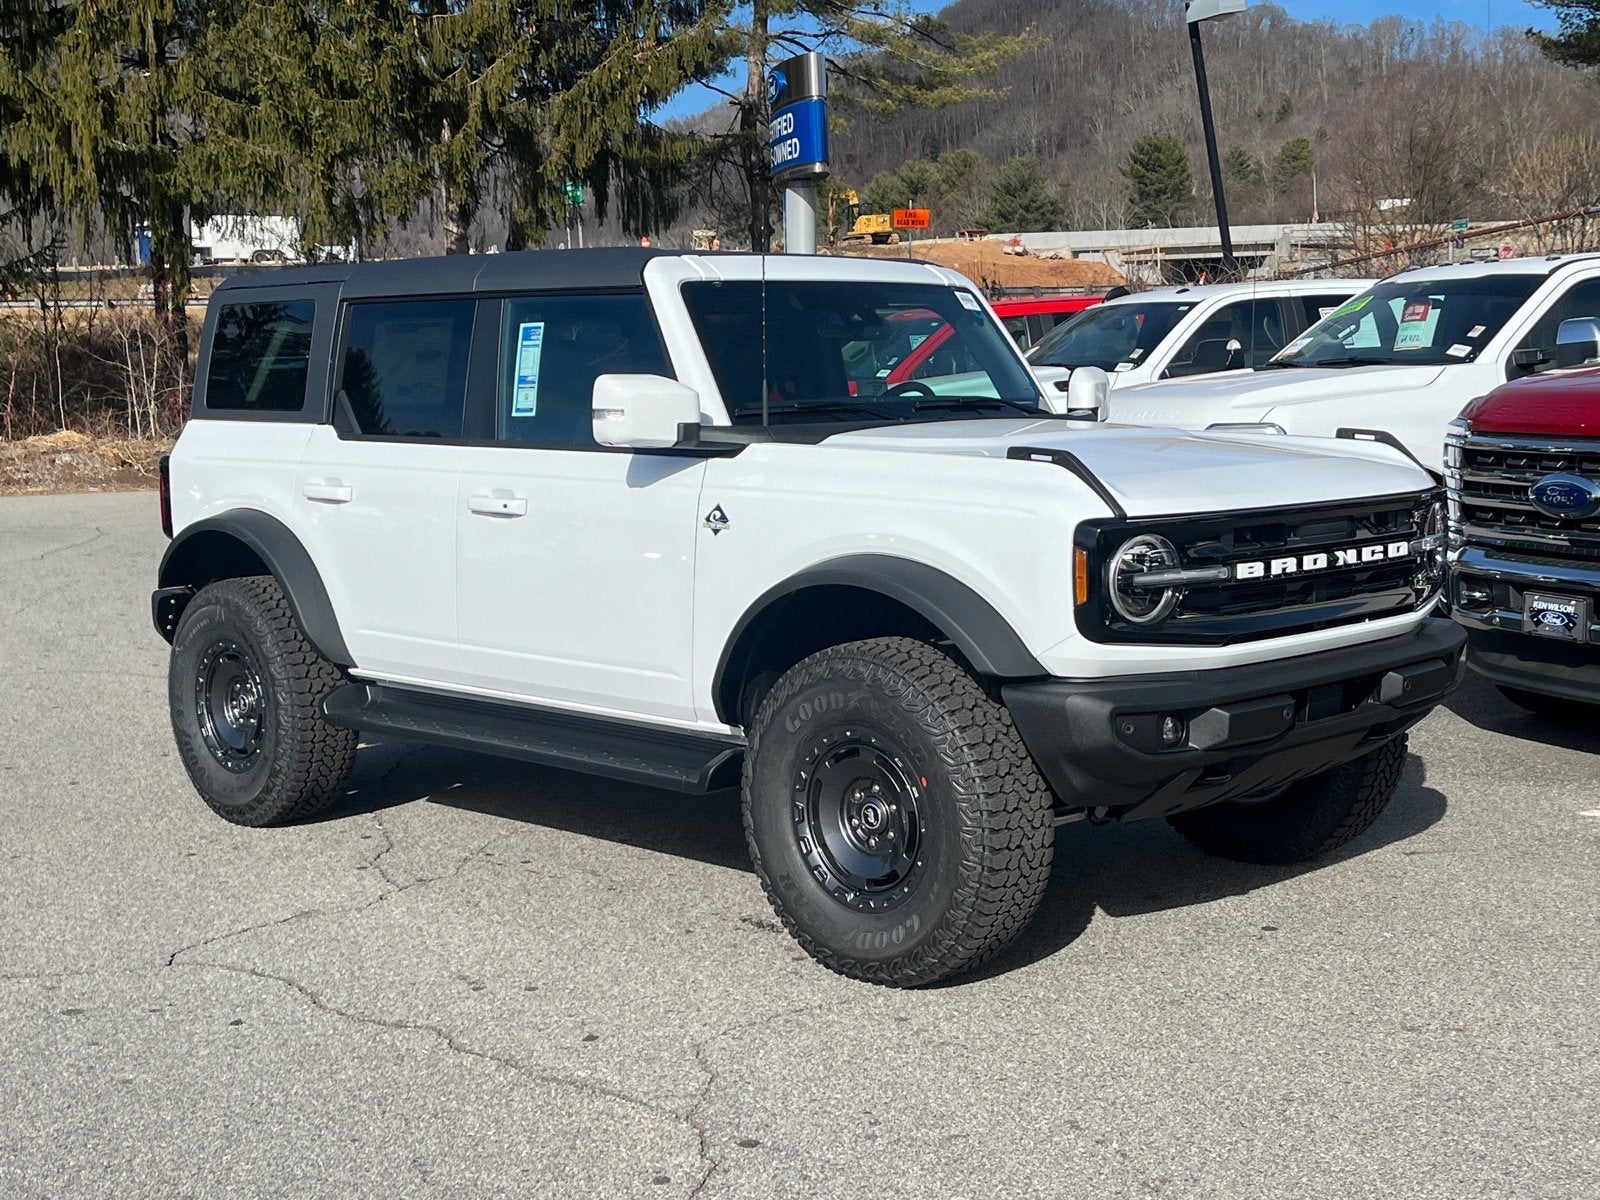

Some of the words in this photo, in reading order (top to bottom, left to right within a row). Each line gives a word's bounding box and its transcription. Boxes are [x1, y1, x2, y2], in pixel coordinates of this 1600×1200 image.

[904, 211, 917, 219] END
[896, 219, 909, 227] ROAD
[911, 219, 925, 227] WORK
[1236, 541, 1409, 580] BRONCO
[1533, 600, 1547, 610] KEN
[1548, 602, 1575, 614] WILSON
[1544, 612, 1564, 625] Ford
